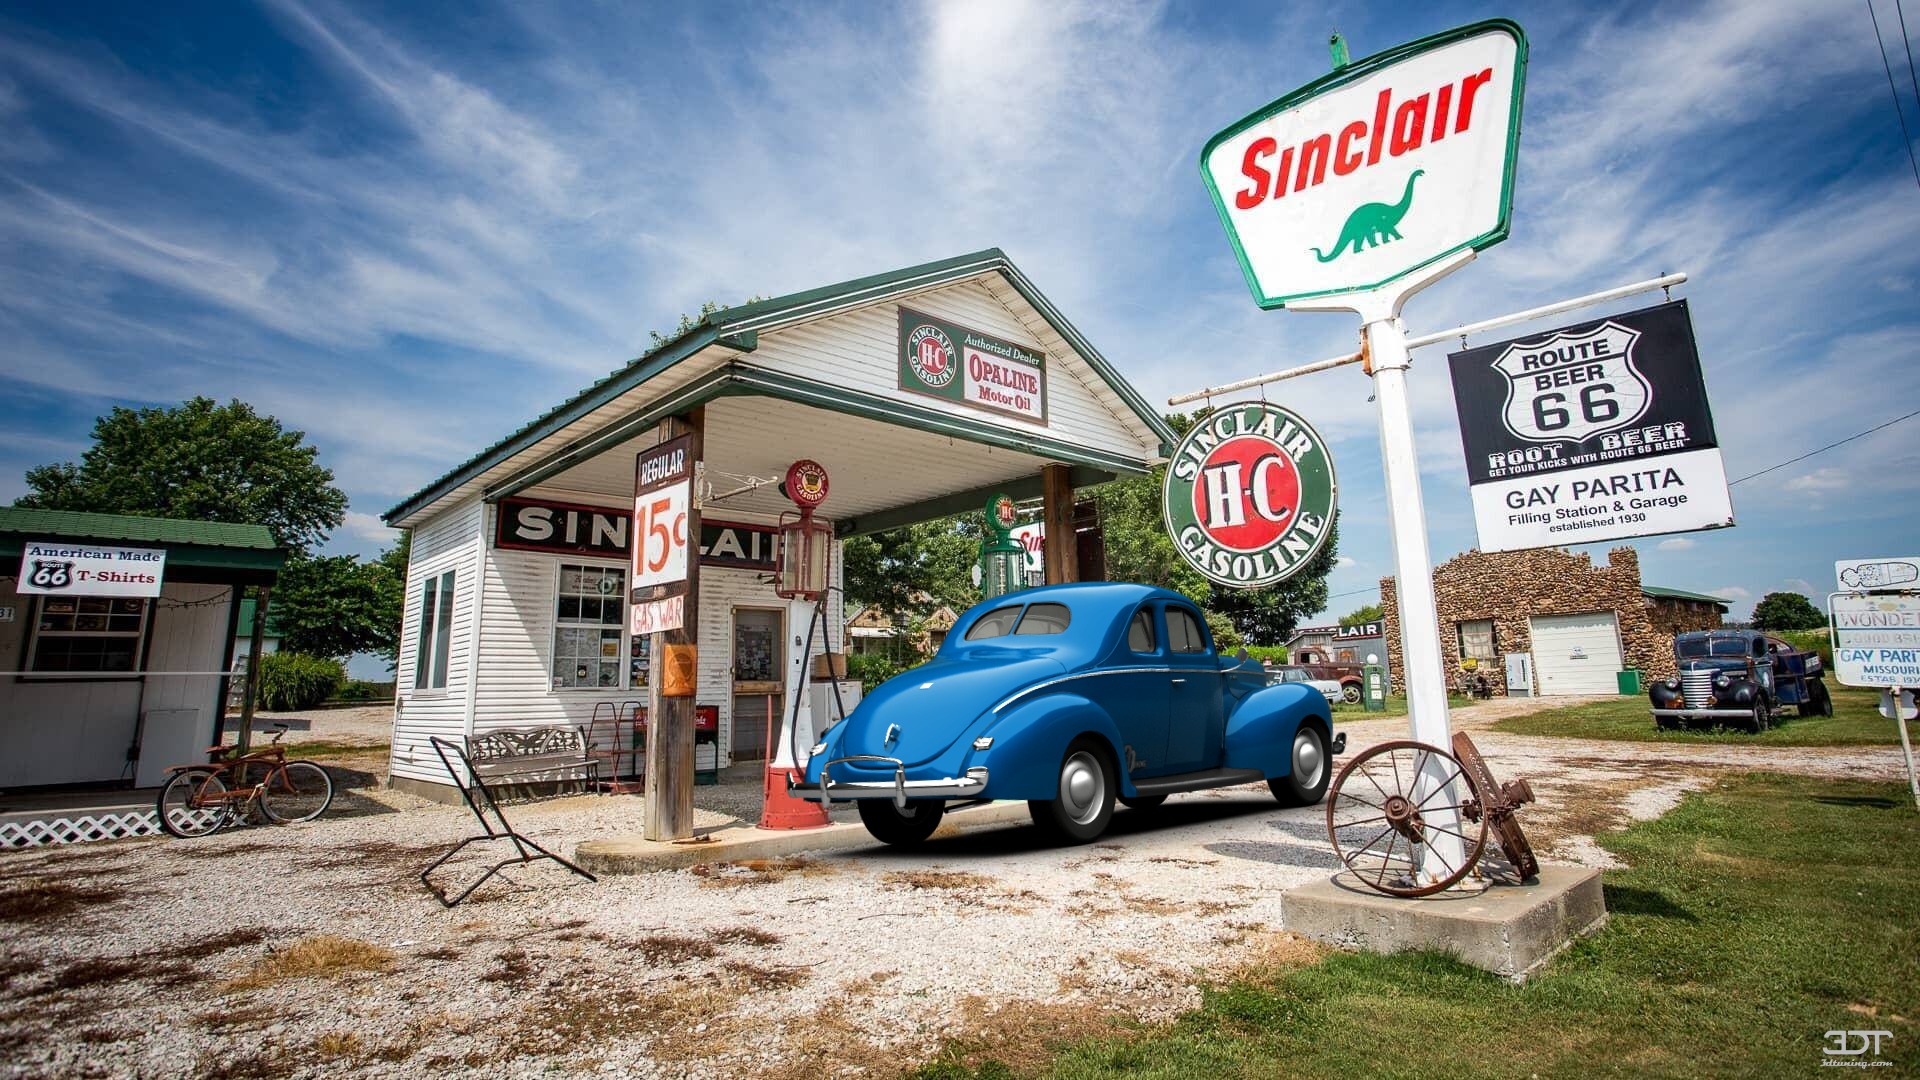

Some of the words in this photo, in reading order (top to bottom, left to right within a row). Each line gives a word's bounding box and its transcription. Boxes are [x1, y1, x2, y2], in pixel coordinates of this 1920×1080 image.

[1235, 67, 1493, 210] Sinclair
[911, 327, 953, 356] SINCLAIR
[965, 333, 1012, 357] Authorized
[1013, 350, 1040, 366] Dealer
[1522, 338, 1610, 372] ROUTE
[911, 355, 954, 385] GASOLINE
[969, 353, 1038, 395] OPALINE
[1535, 364, 1605, 392] BEER
[978, 385, 1013, 405] Motor
[1015, 395, 1031, 411] Oil
[1532, 383, 1620, 432] 66
[1174, 411, 1313, 482] SINCLAIR
[1488, 442, 1563, 469] ROOT
[1599, 421, 1686, 449] BEER
[1488, 467, 1507, 478] GET
[1508, 463, 1535, 475] YOUR
[1537, 458, 1568, 471] KICKS
[1570, 453, 1598, 465] WITH
[1600, 447, 1635, 460] ROUTE
[1637, 444, 1652, 454] 66
[641, 448, 684, 486] REGULAR
[1202, 453, 1292, 530] H-C
[1505, 484, 1561, 510] GAY
[1572, 467, 1685, 501] PARITA
[1508, 510, 1551, 526] Filling
[1555, 504, 1608, 520] Station
[1613, 501, 1625, 512] &
[1630, 493, 1689, 510] Garage
[1549, 516, 1615, 533] established
[1618, 512, 1647, 525] 1930
[29, 546, 113, 560] American
[119, 551, 161, 562] Made
[1180, 511, 1324, 581] GASOLINE
[34, 568, 67, 585] 66
[77, 570, 155, 584] T-Shirts
[633, 602, 655, 632] GAS
[659, 597, 683, 628] WAR
[1840, 612, 1920, 627] WONDE
[1840, 649, 1874, 662] GAY
